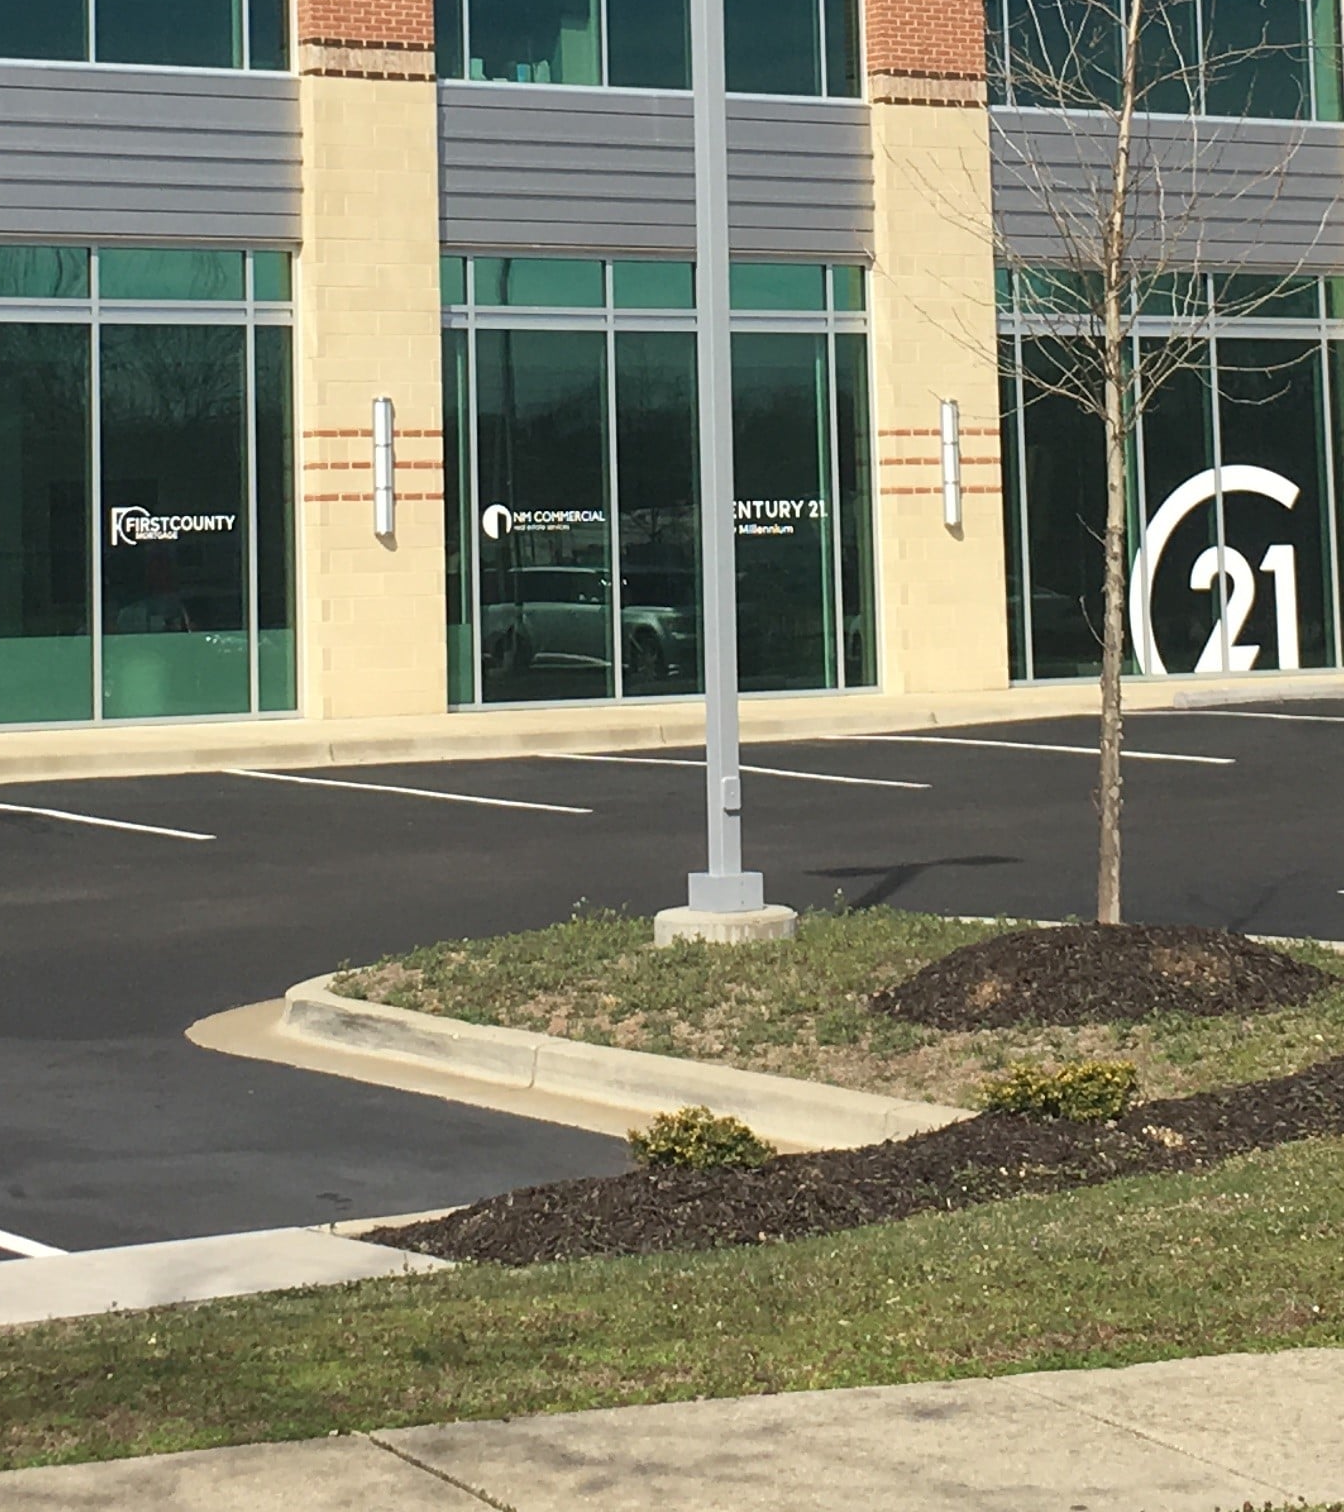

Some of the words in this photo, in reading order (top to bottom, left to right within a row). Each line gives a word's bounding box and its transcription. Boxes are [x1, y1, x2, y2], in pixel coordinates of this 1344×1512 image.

[513, 511, 532, 522] NM
[534, 510, 606, 522] COMMERCIAL
[733, 499, 805, 519] NTURY
[808, 499, 828, 518] 21
[126, 514, 236, 533] FIRSTCOUNTY
[738, 523, 795, 535] Millennium
